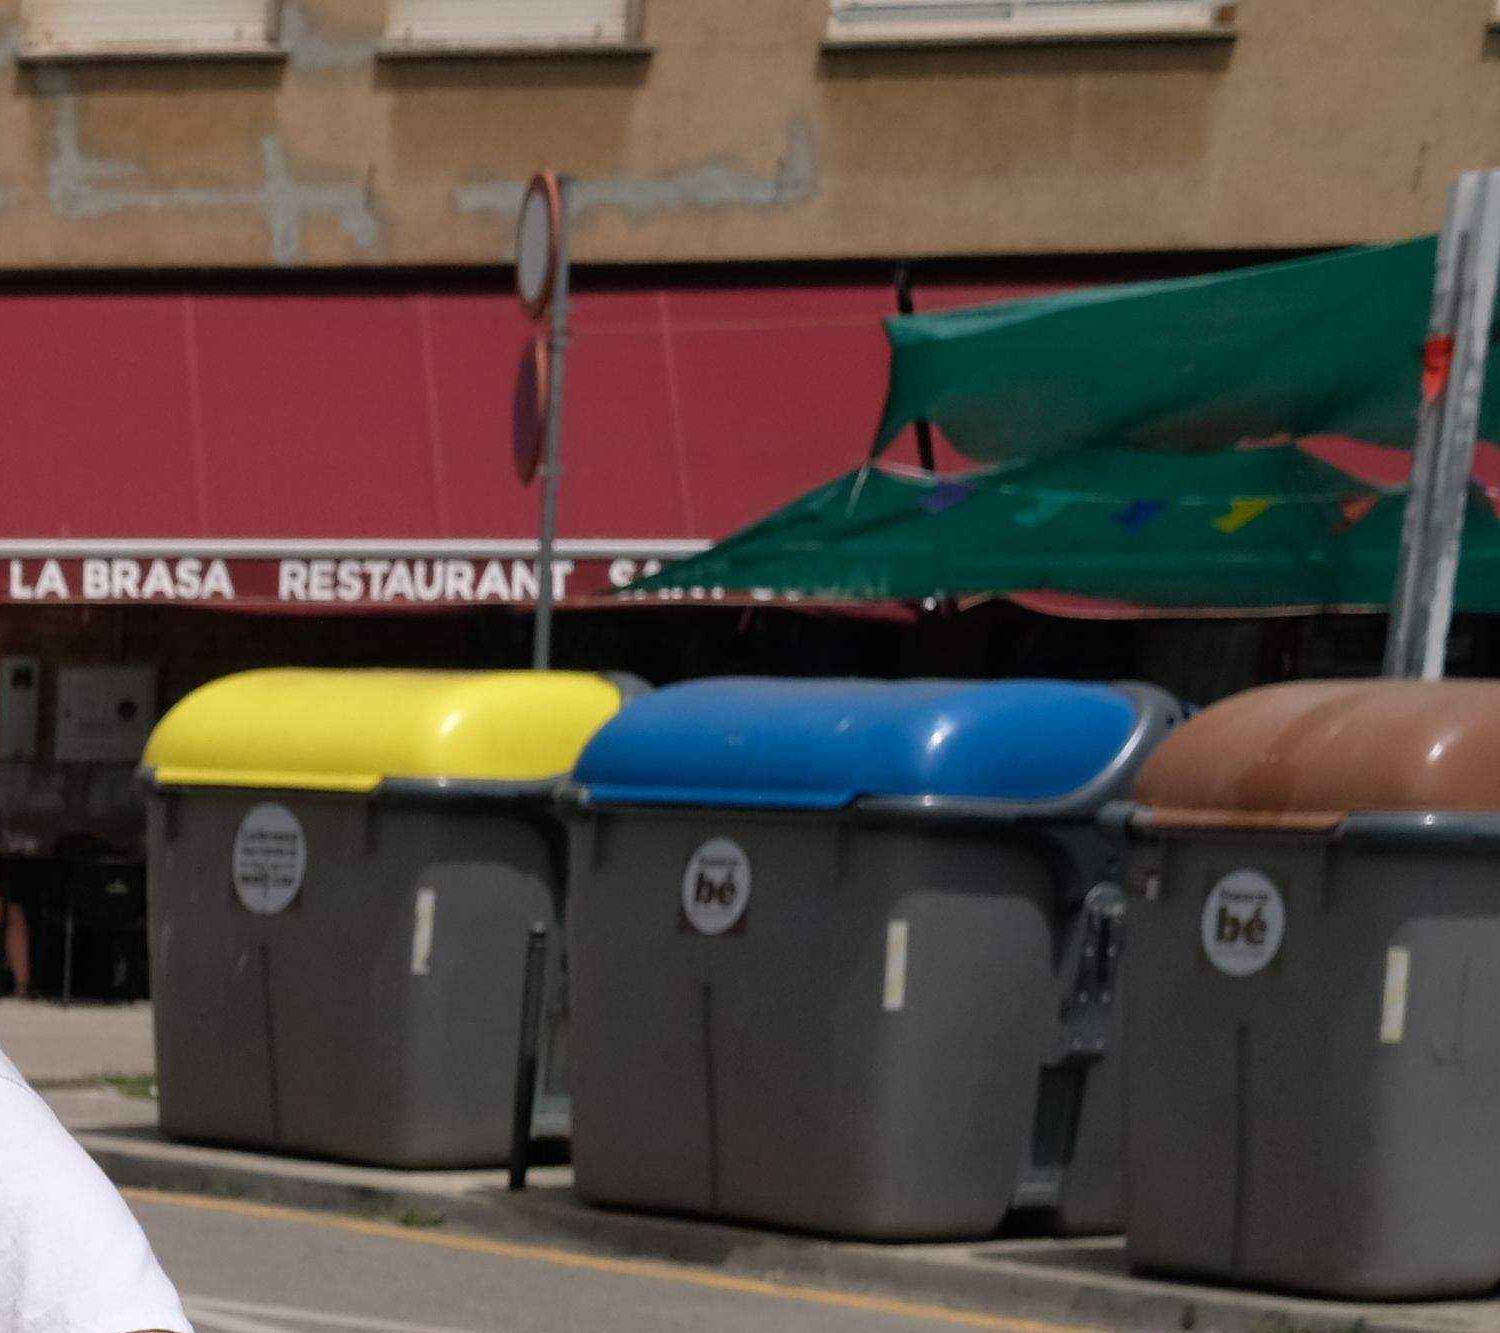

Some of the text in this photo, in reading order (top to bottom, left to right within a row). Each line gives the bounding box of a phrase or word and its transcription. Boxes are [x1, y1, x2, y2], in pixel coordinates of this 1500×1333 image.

[9, 558, 69, 599] LA
[82, 558, 235, 600] BRASA
[278, 557, 574, 601] RESTAURANT
[695, 870, 737, 906] bé
[1216, 906, 1268, 946] bé
